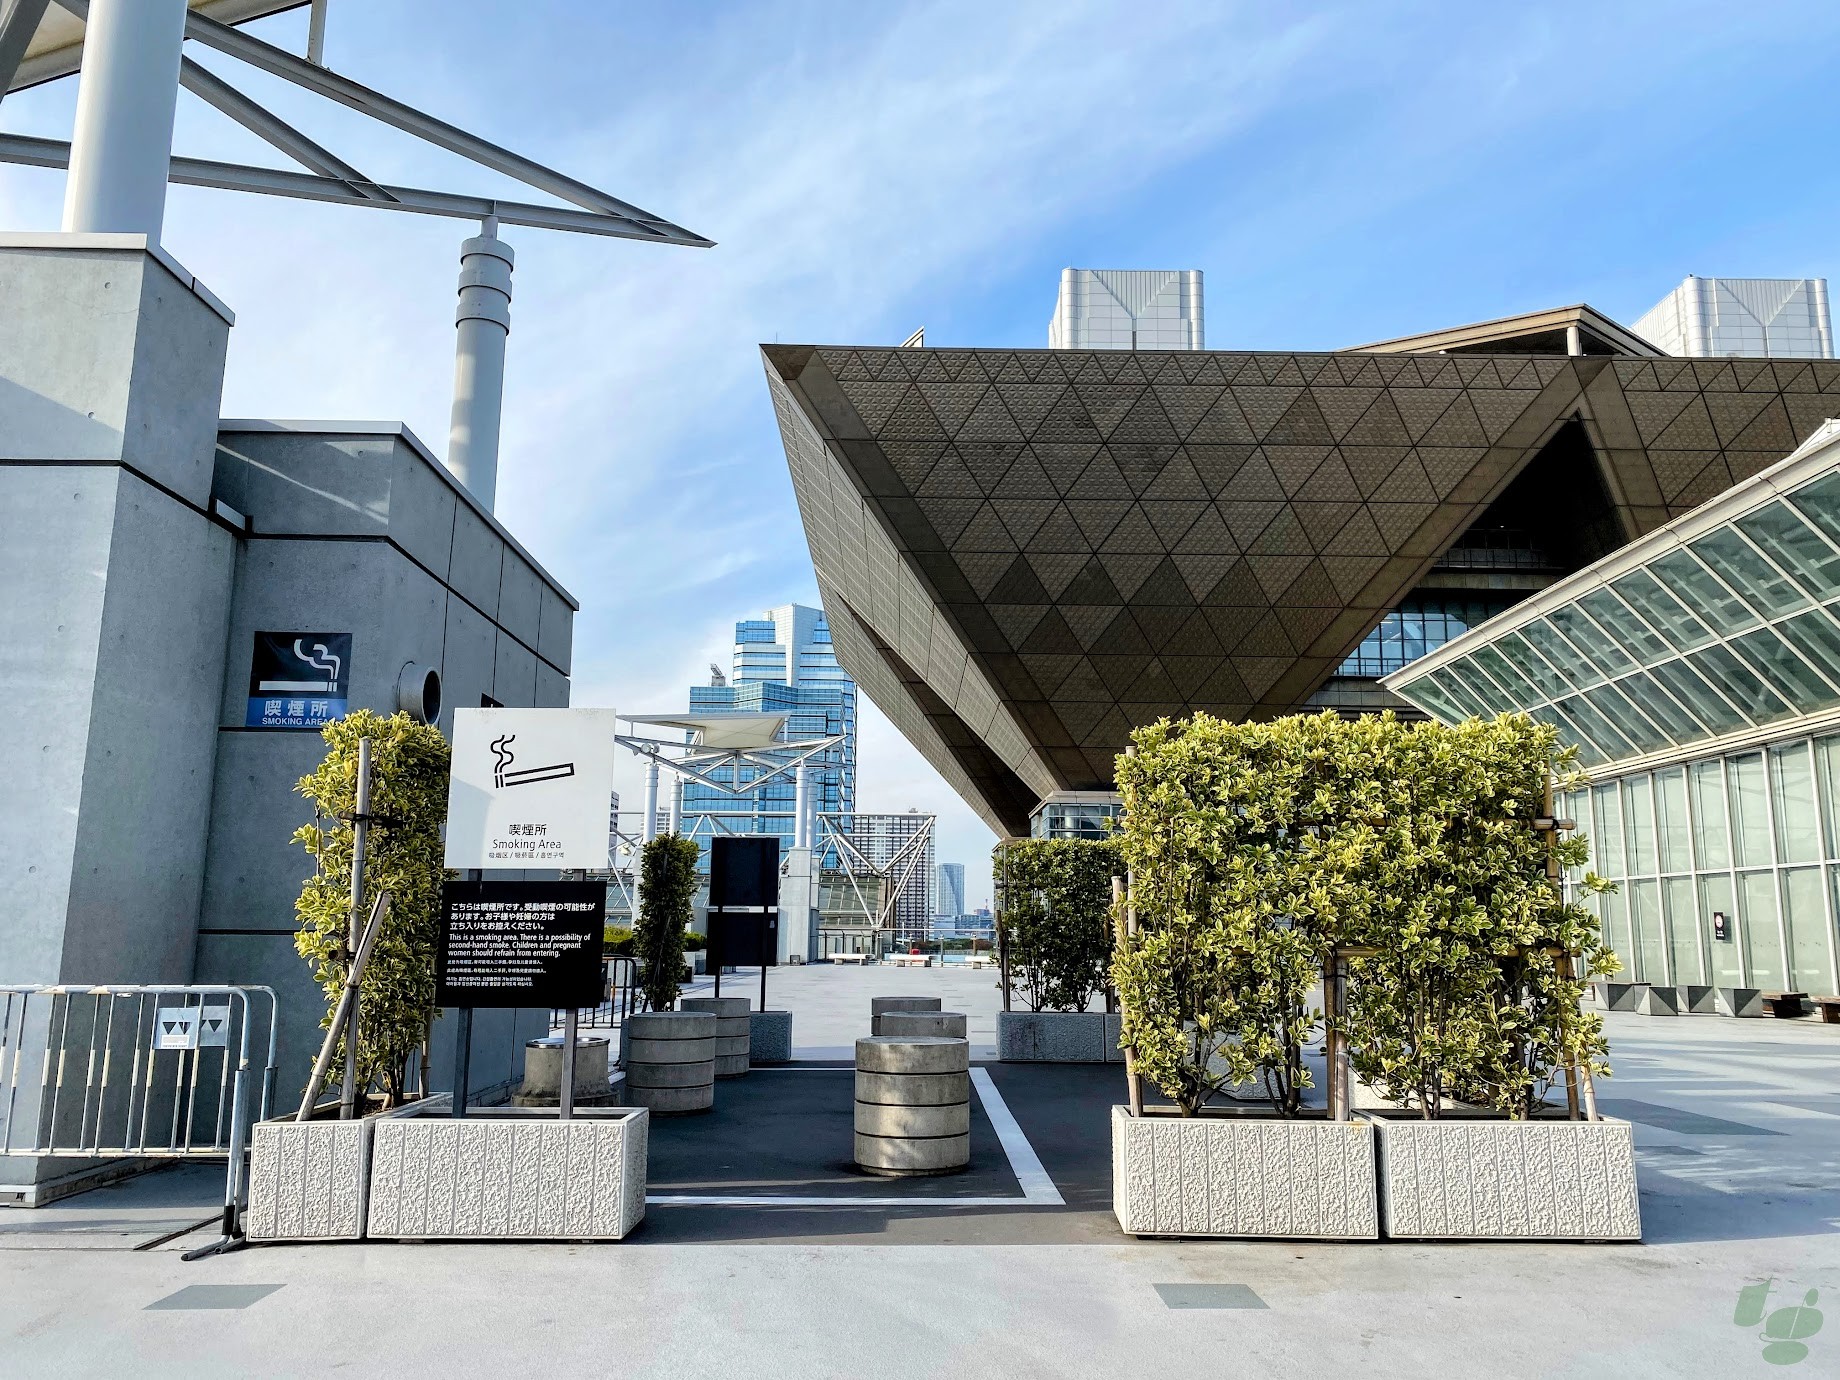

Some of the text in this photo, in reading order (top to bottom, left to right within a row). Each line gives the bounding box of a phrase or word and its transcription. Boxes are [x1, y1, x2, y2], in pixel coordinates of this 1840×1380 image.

[264, 700, 328, 718] 喫煙所
[508, 824, 547, 836] 喫煙所
[492, 839, 562, 851] Smoking Area
[475, 933, 501, 942] smoking
[551, 933, 582, 942] possibility
[553, 942, 581, 950] pregnant
[533, 949, 560, 958] entering.
